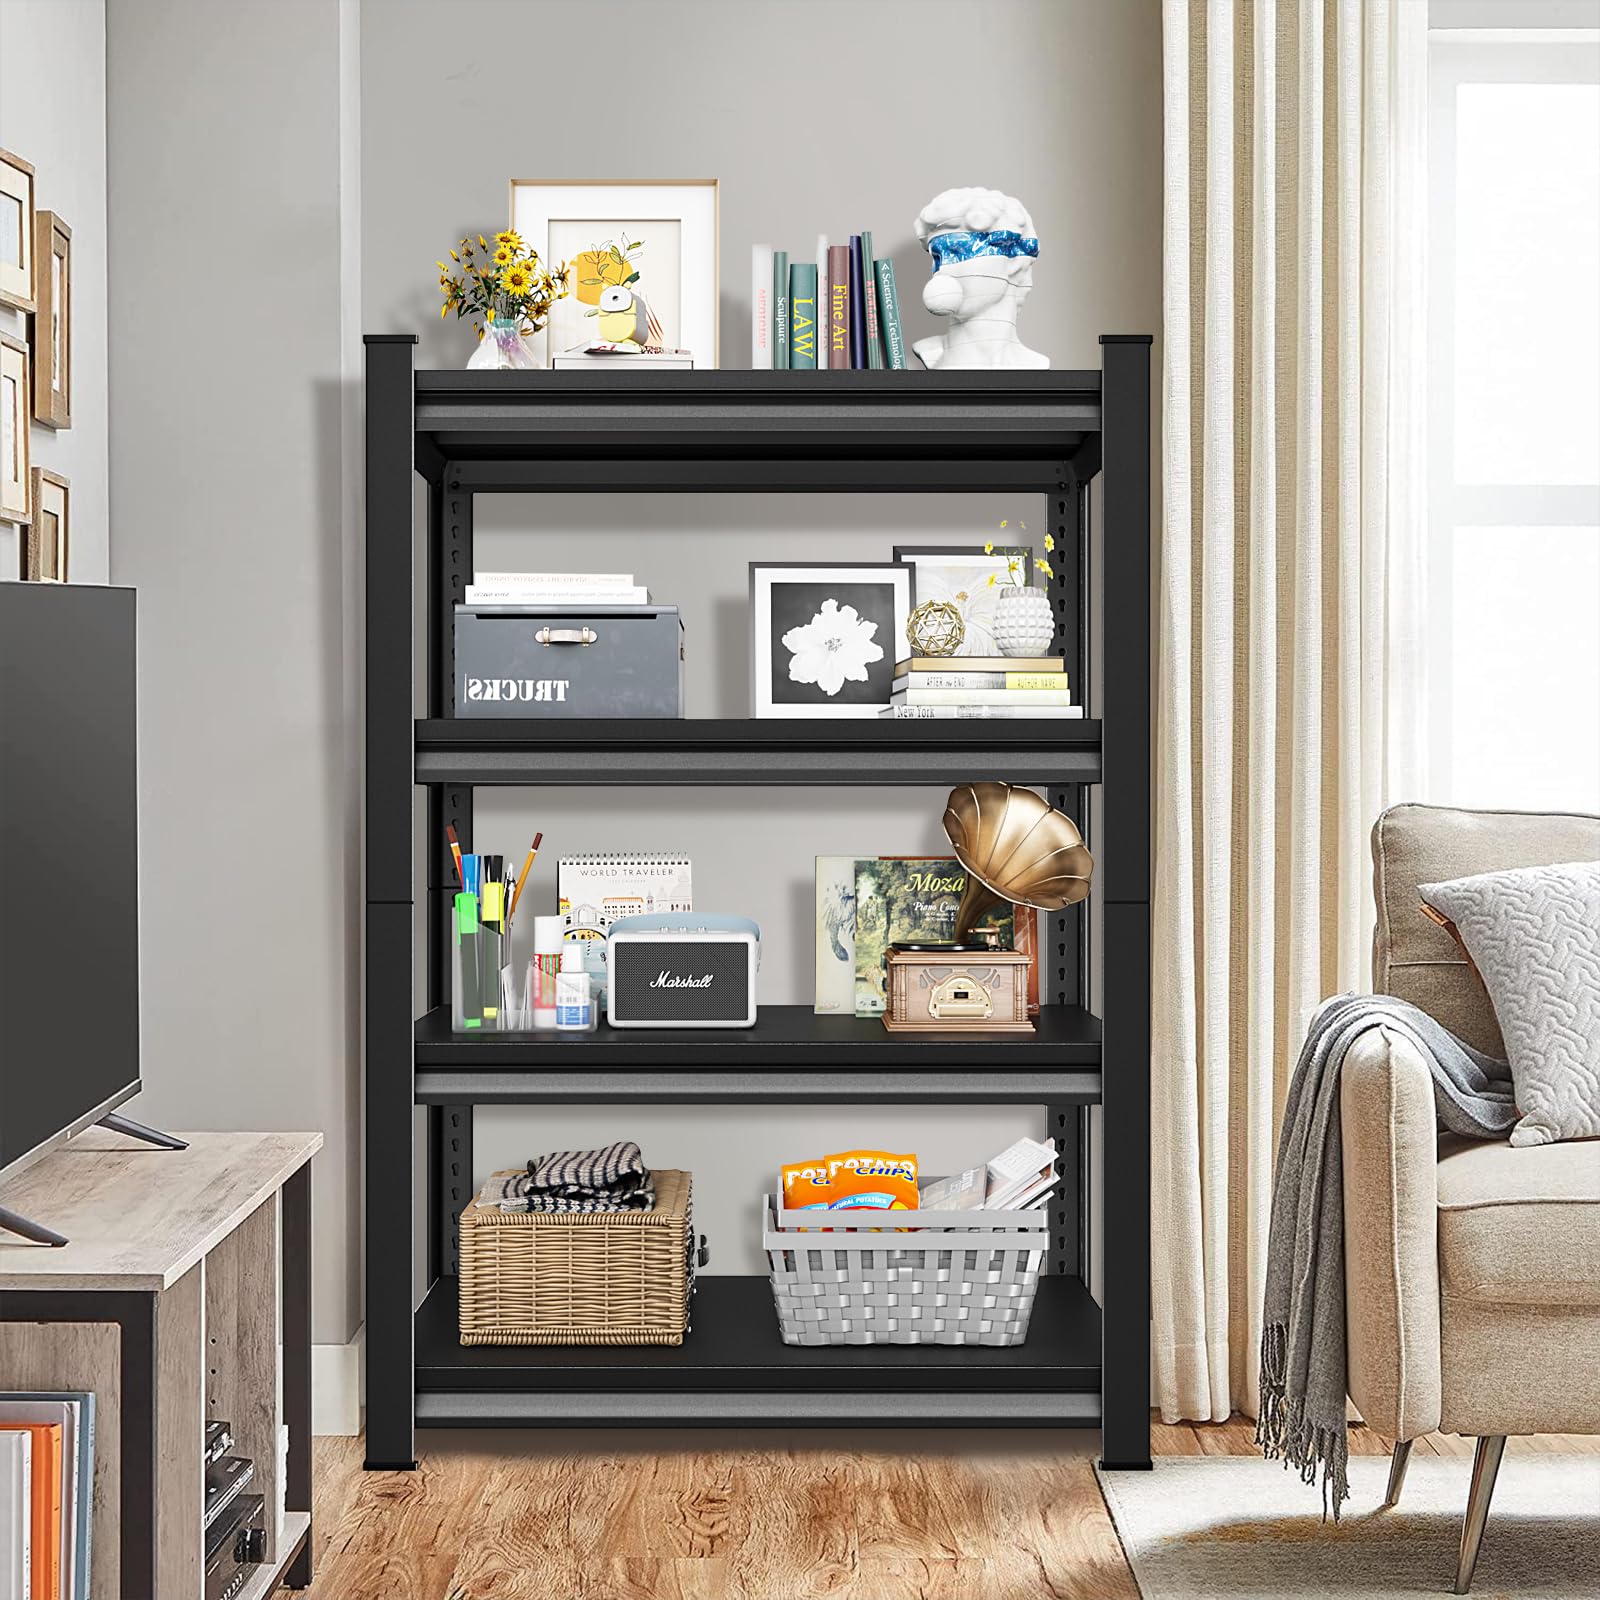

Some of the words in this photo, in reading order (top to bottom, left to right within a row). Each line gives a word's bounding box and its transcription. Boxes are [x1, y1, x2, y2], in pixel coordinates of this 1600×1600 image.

[882, 273, 893, 310] Science
[832, 284, 847, 320] Fine
[776, 296, 787, 344] Sculpture
[793, 297, 814, 359] LAW
[832, 324, 847, 351] Art
[897, 705, 914, 719] New
[917, 705, 935, 719] York
[580, 868, 618, 877] WORLD
[623, 867, 674, 877] TRAVELER
[904, 873, 964, 892] Moza
[912, 901, 937, 912] Piano
[650, 971, 713, 988] Marshall
[855, 1167, 914, 1181] CHIPS
